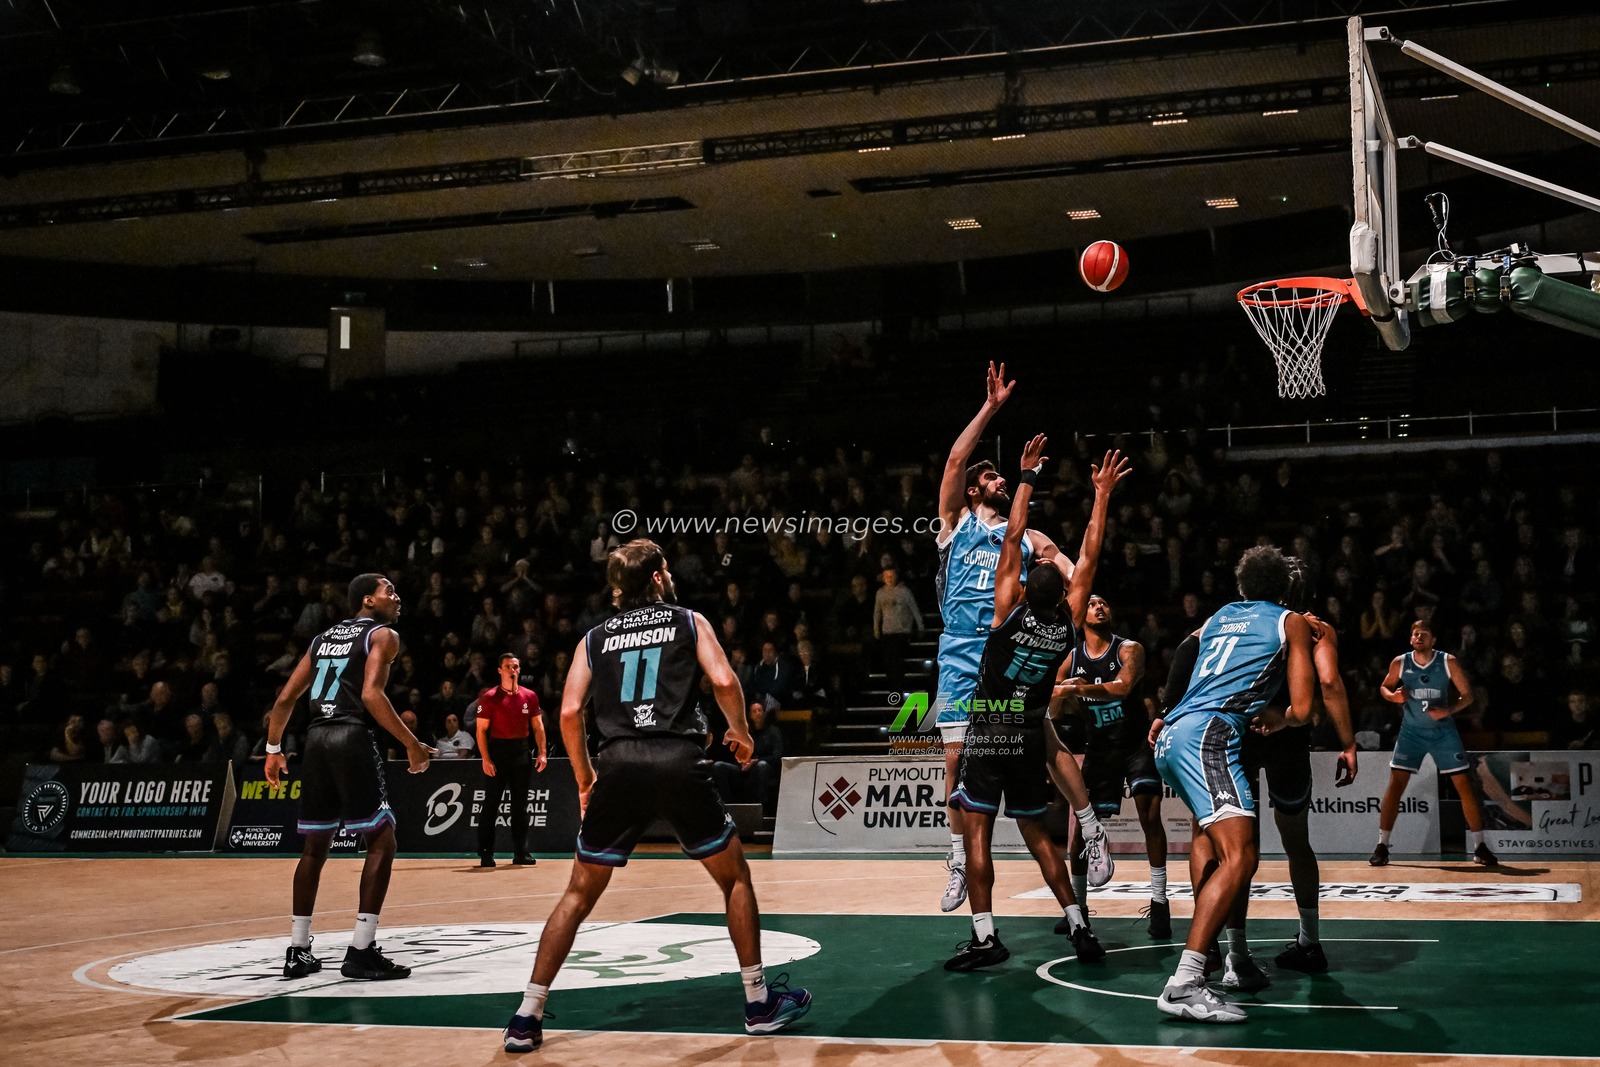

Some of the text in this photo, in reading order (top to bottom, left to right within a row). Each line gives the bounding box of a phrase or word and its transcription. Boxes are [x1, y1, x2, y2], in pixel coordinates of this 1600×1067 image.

[622, 617, 672, 629] UNIVERSITY
[623, 610, 673, 624] MARJON
[601, 627, 677, 654] JOHNSON
[1002, 645, 1058, 685] 15
[1198, 635, 1240, 678] 21
[620, 646, 663, 703] 11
[79, 780, 213, 804] YOUR LOGO HERE
[76, 805, 207, 817] CONTACT US FOR SPONSORSHIP INFO
[1539, 802, 1582, 834] Great
[70, 829, 203, 840] COMMERCIAL@PLYMOUTHCITYPATRIOTS.COM
[243, 832, 282, 841] MARJON
